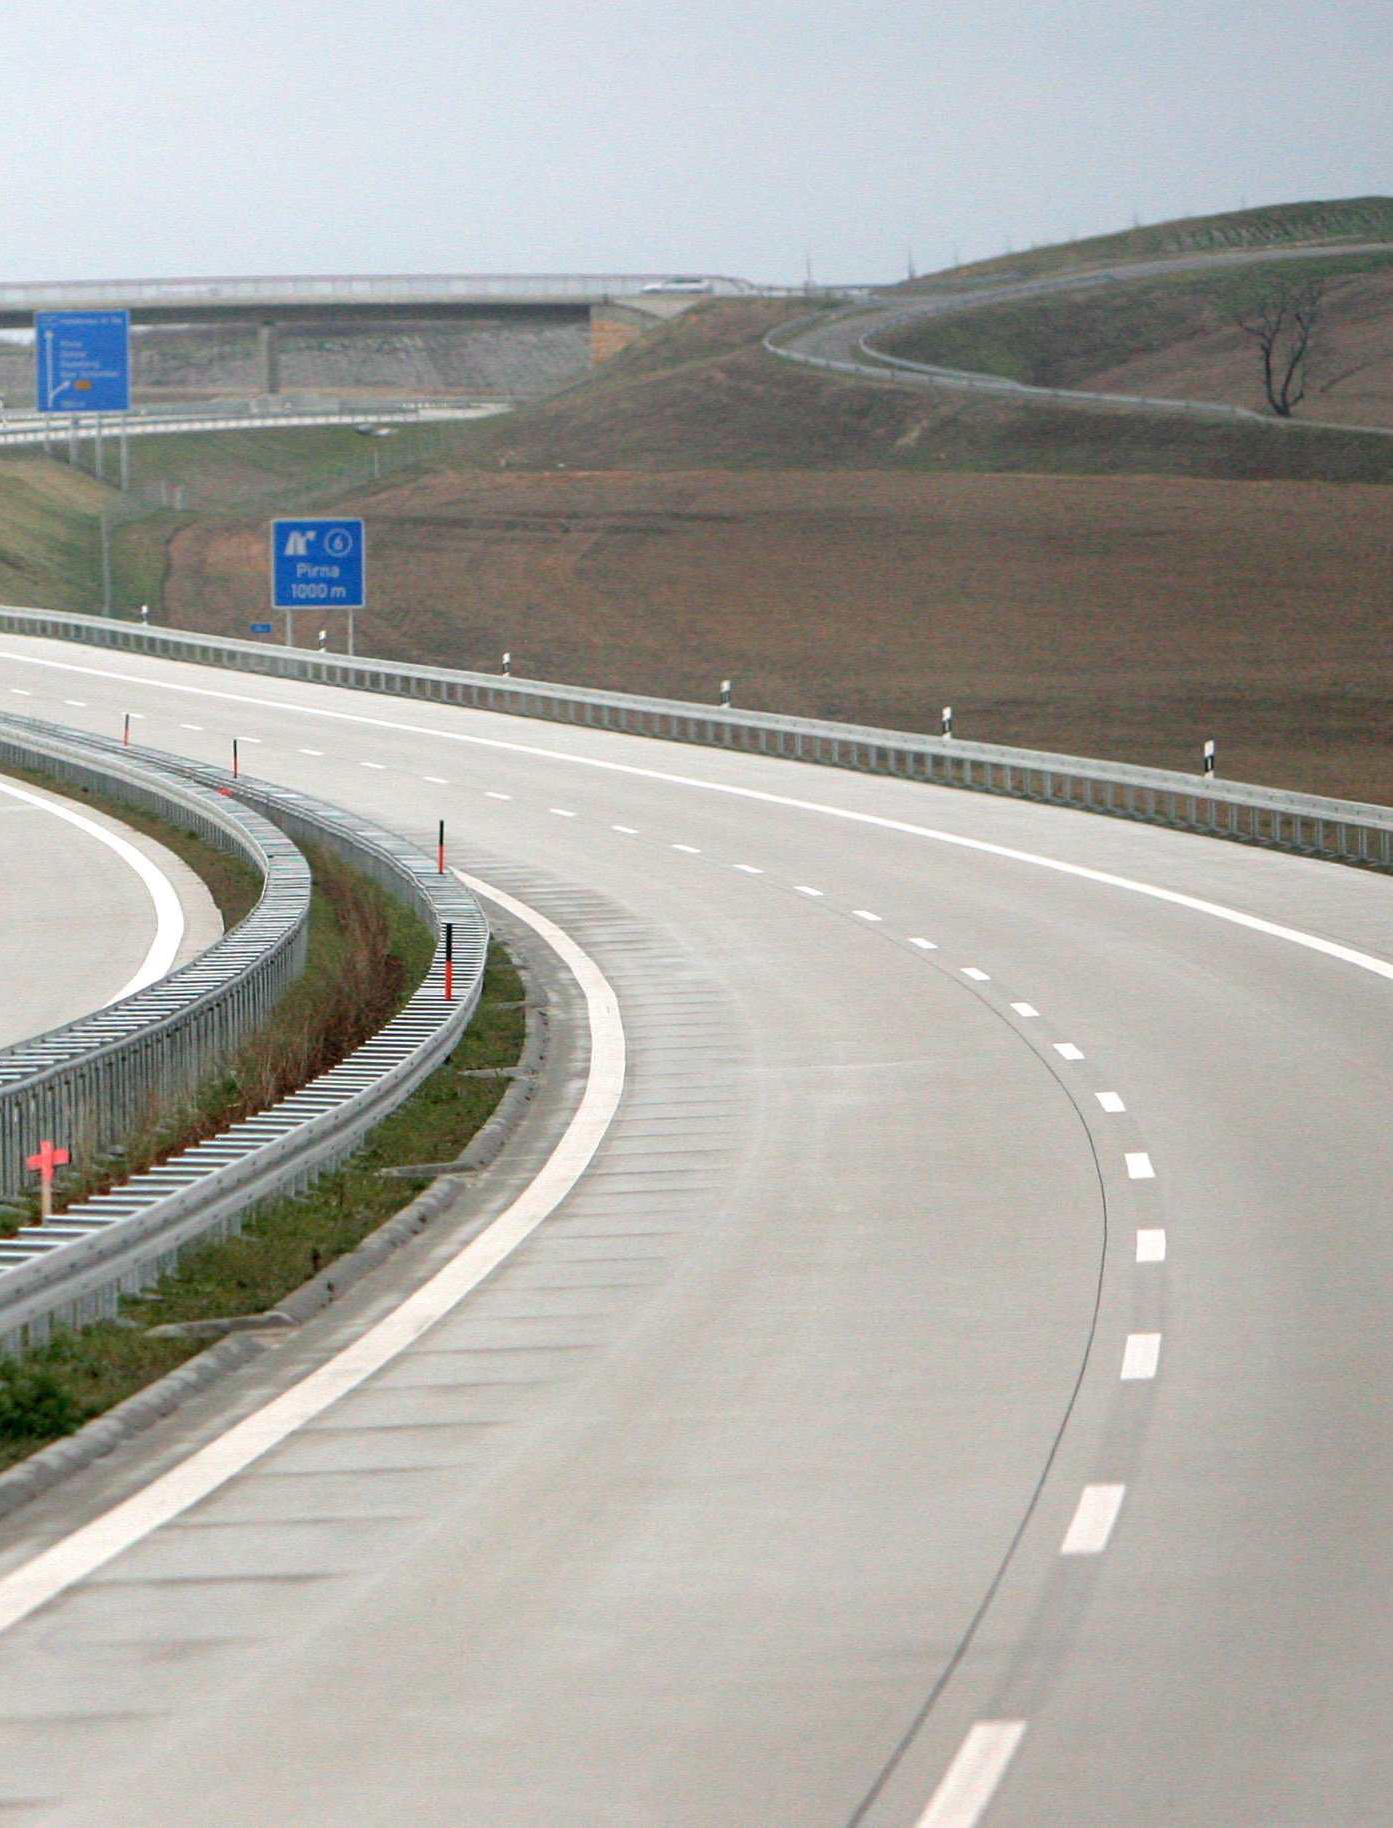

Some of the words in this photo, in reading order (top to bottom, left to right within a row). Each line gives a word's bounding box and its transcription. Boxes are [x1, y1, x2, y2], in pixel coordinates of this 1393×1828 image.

[296, 563, 340, 578] Pirna
[291, 583, 328, 599] 1000
[330, 586, 346, 598] m
